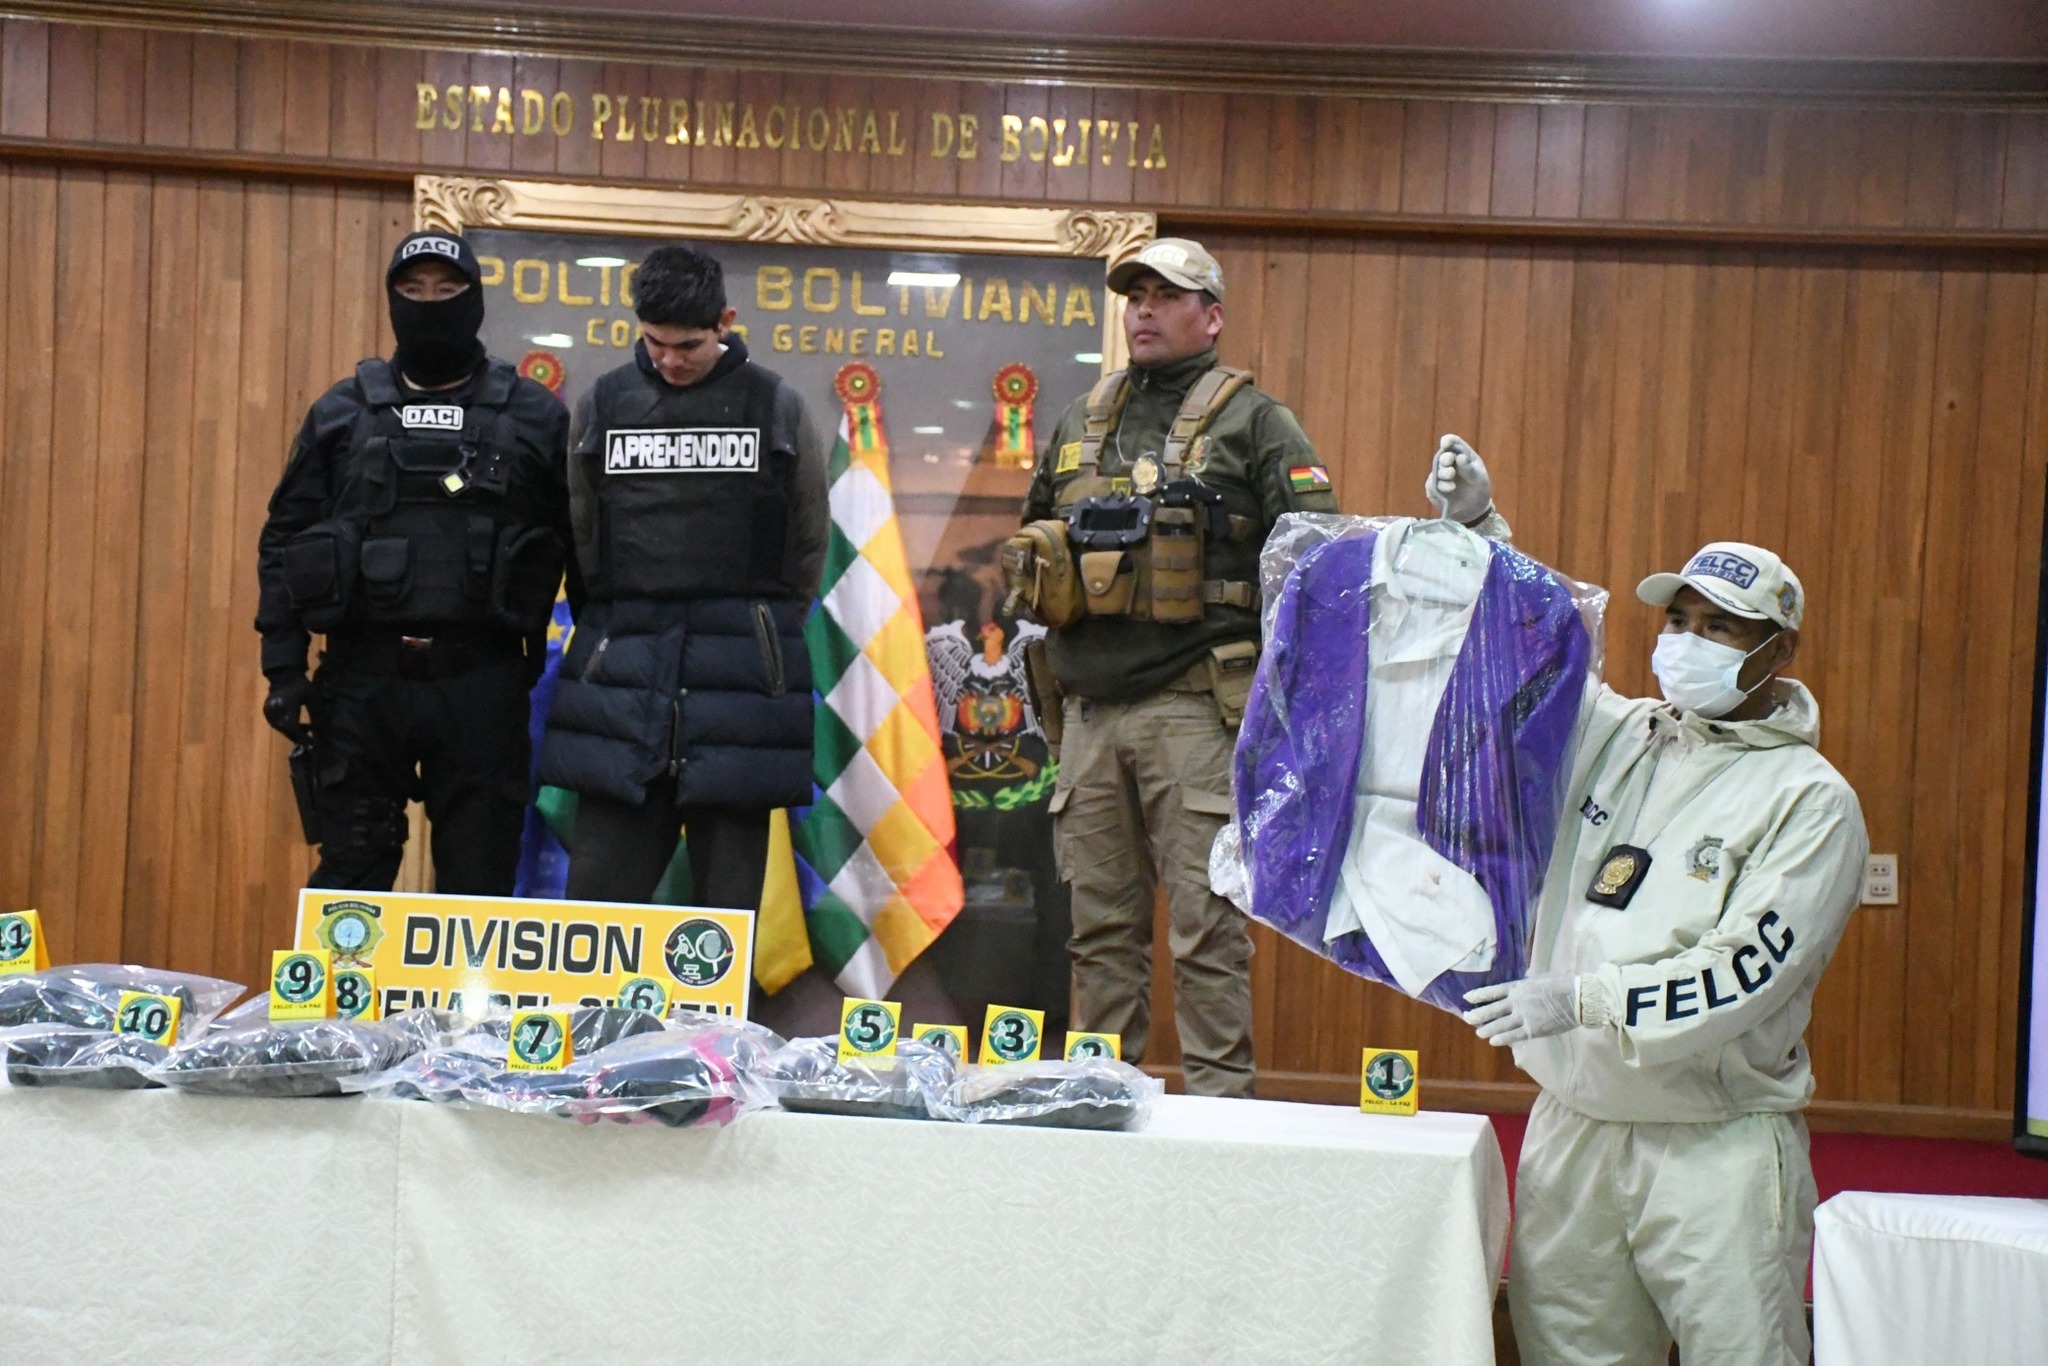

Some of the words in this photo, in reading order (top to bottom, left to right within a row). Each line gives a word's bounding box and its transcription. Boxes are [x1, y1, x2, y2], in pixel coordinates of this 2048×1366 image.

[415, 83, 574, 137] ESTADO
[591, 93, 906, 155] PLURINACIONAL
[931, 112, 979, 159] DE
[1001, 114, 1167, 169] BOLIVIA
[406, 240, 456, 256] DACI
[756, 265, 1096, 327] BOLIVIANA
[772, 324, 944, 359] GENERAL
[406, 408, 460, 426] DACI
[609, 434, 755, 468] APREHENDIDO
[1690, 555, 1752, 577] FELCC
[403, 915, 643, 973] DIVISION
[288, 961, 312, 994] 9
[1625, 910, 1795, 1027] FELCC
[336, 977, 359, 1009] 8
[631, 984, 654, 1010] 6
[123, 1006, 168, 1035] 10
[528, 1020, 550, 1054] 7
[857, 1009, 881, 1043] 5
[1001, 1018, 1025, 1052] 3
[1378, 1057, 1399, 1090] 1
